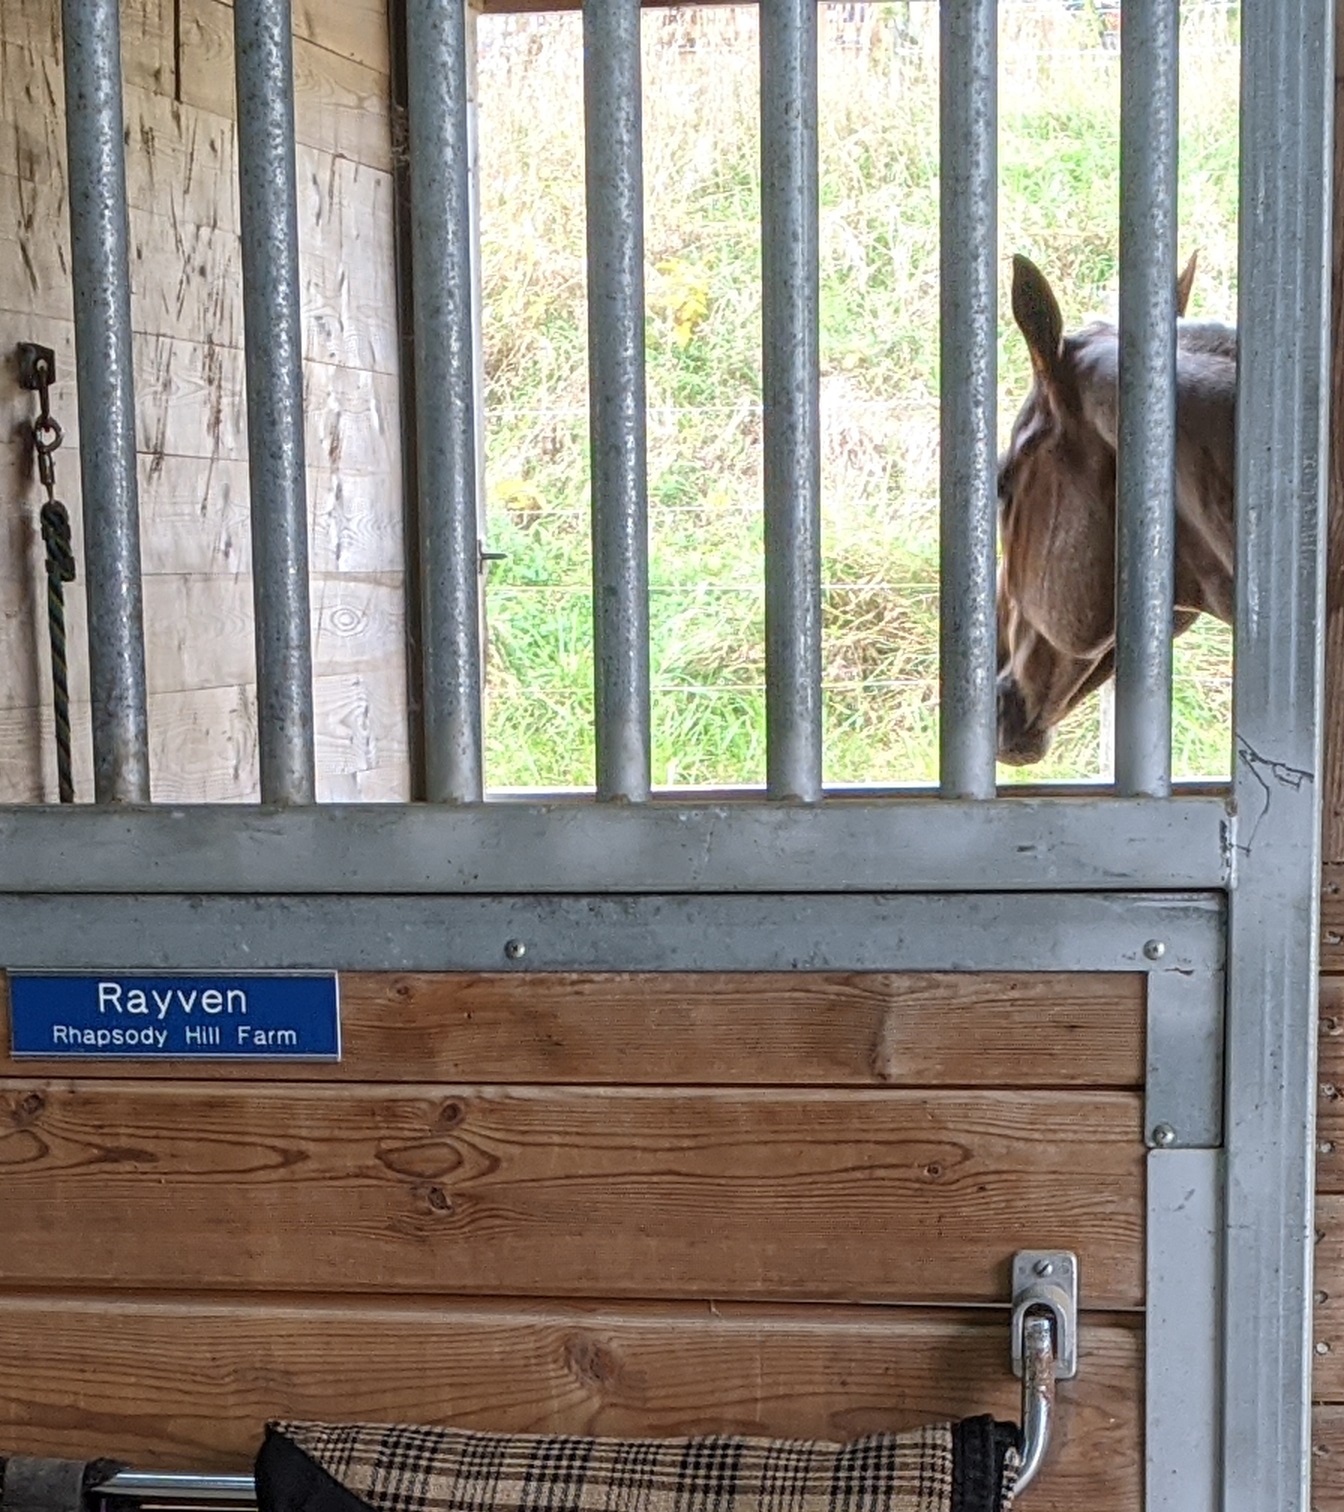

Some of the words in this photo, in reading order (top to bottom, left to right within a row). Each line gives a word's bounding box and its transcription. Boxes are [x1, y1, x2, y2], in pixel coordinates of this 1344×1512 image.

[97, 982, 248, 1019] Rayven
[53, 1025, 167, 1048] Rhapsody
[185, 1025, 221, 1045] Hill
[237, 1025, 298, 1046] Farm
